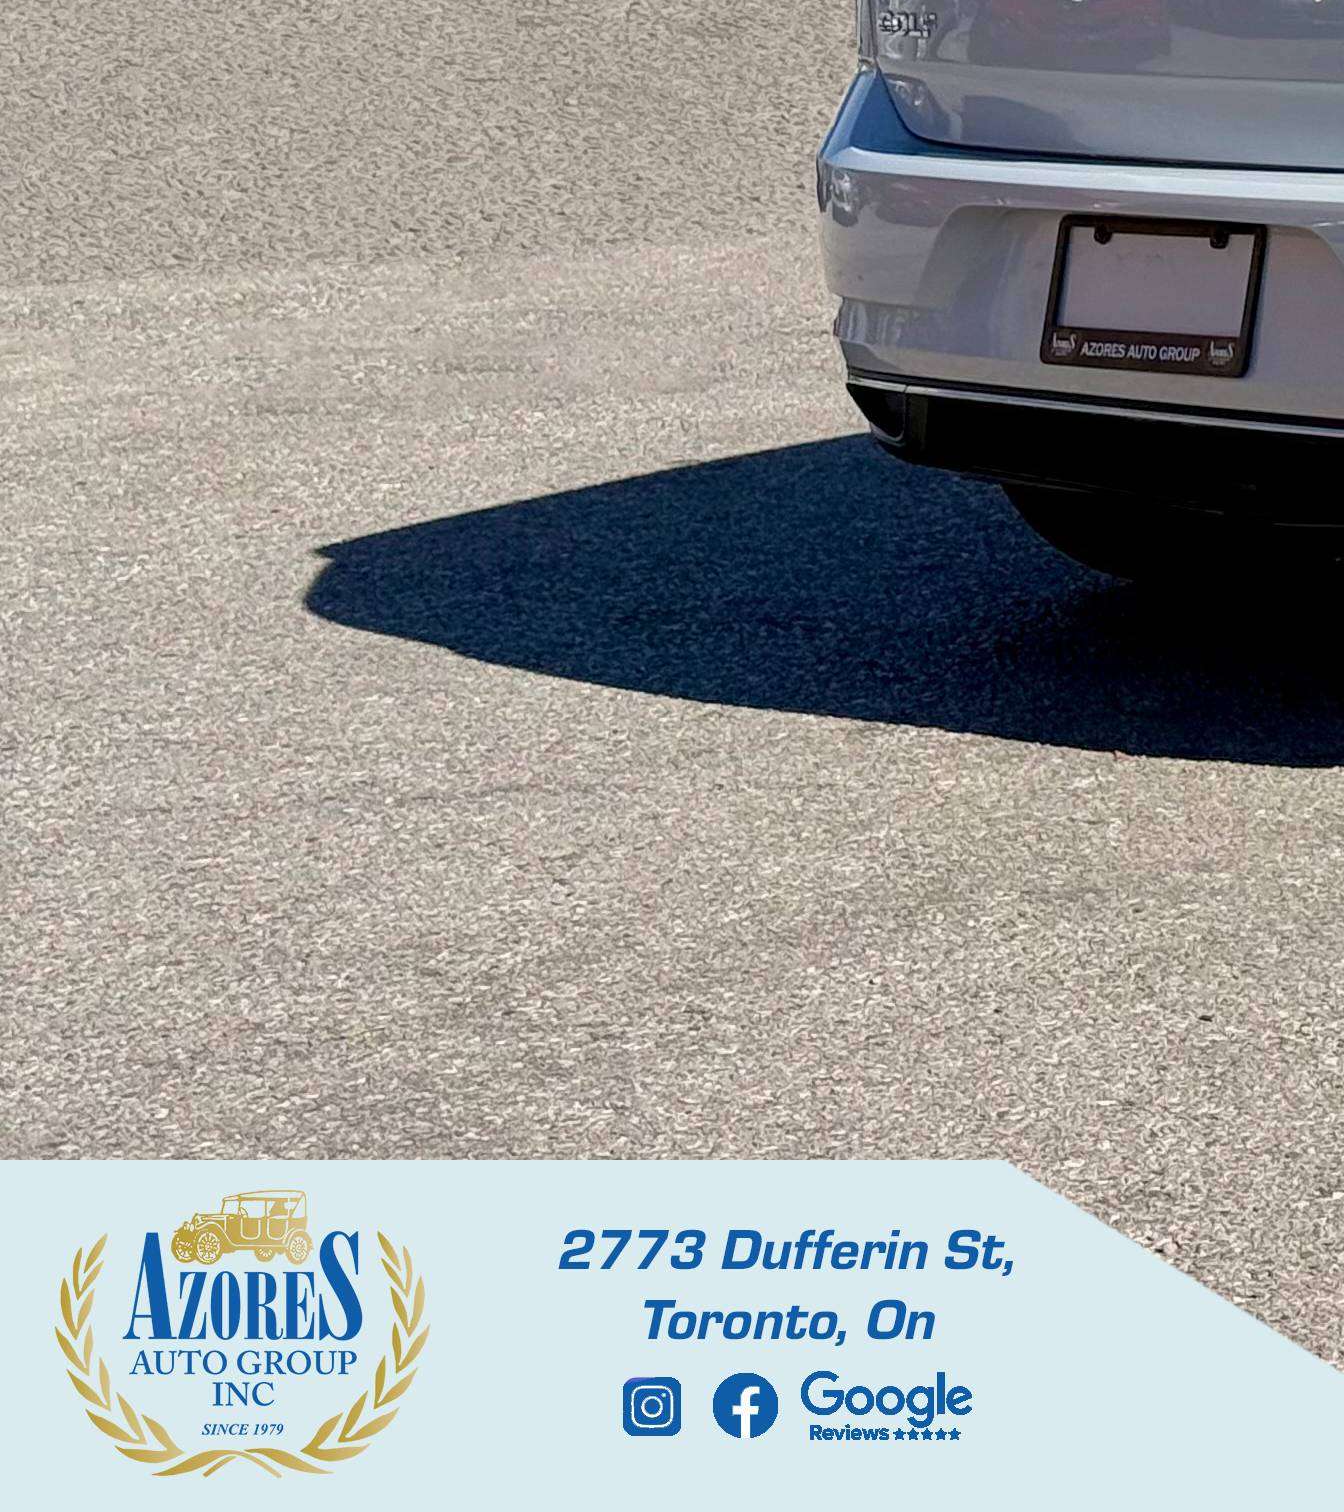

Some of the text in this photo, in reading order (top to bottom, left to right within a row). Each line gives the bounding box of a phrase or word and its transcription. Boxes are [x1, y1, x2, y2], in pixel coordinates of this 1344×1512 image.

[1080, 341, 1126, 358] AZORES
[1127, 344, 1157, 360] AUTO
[1160, 346, 1201, 362] GROUP
